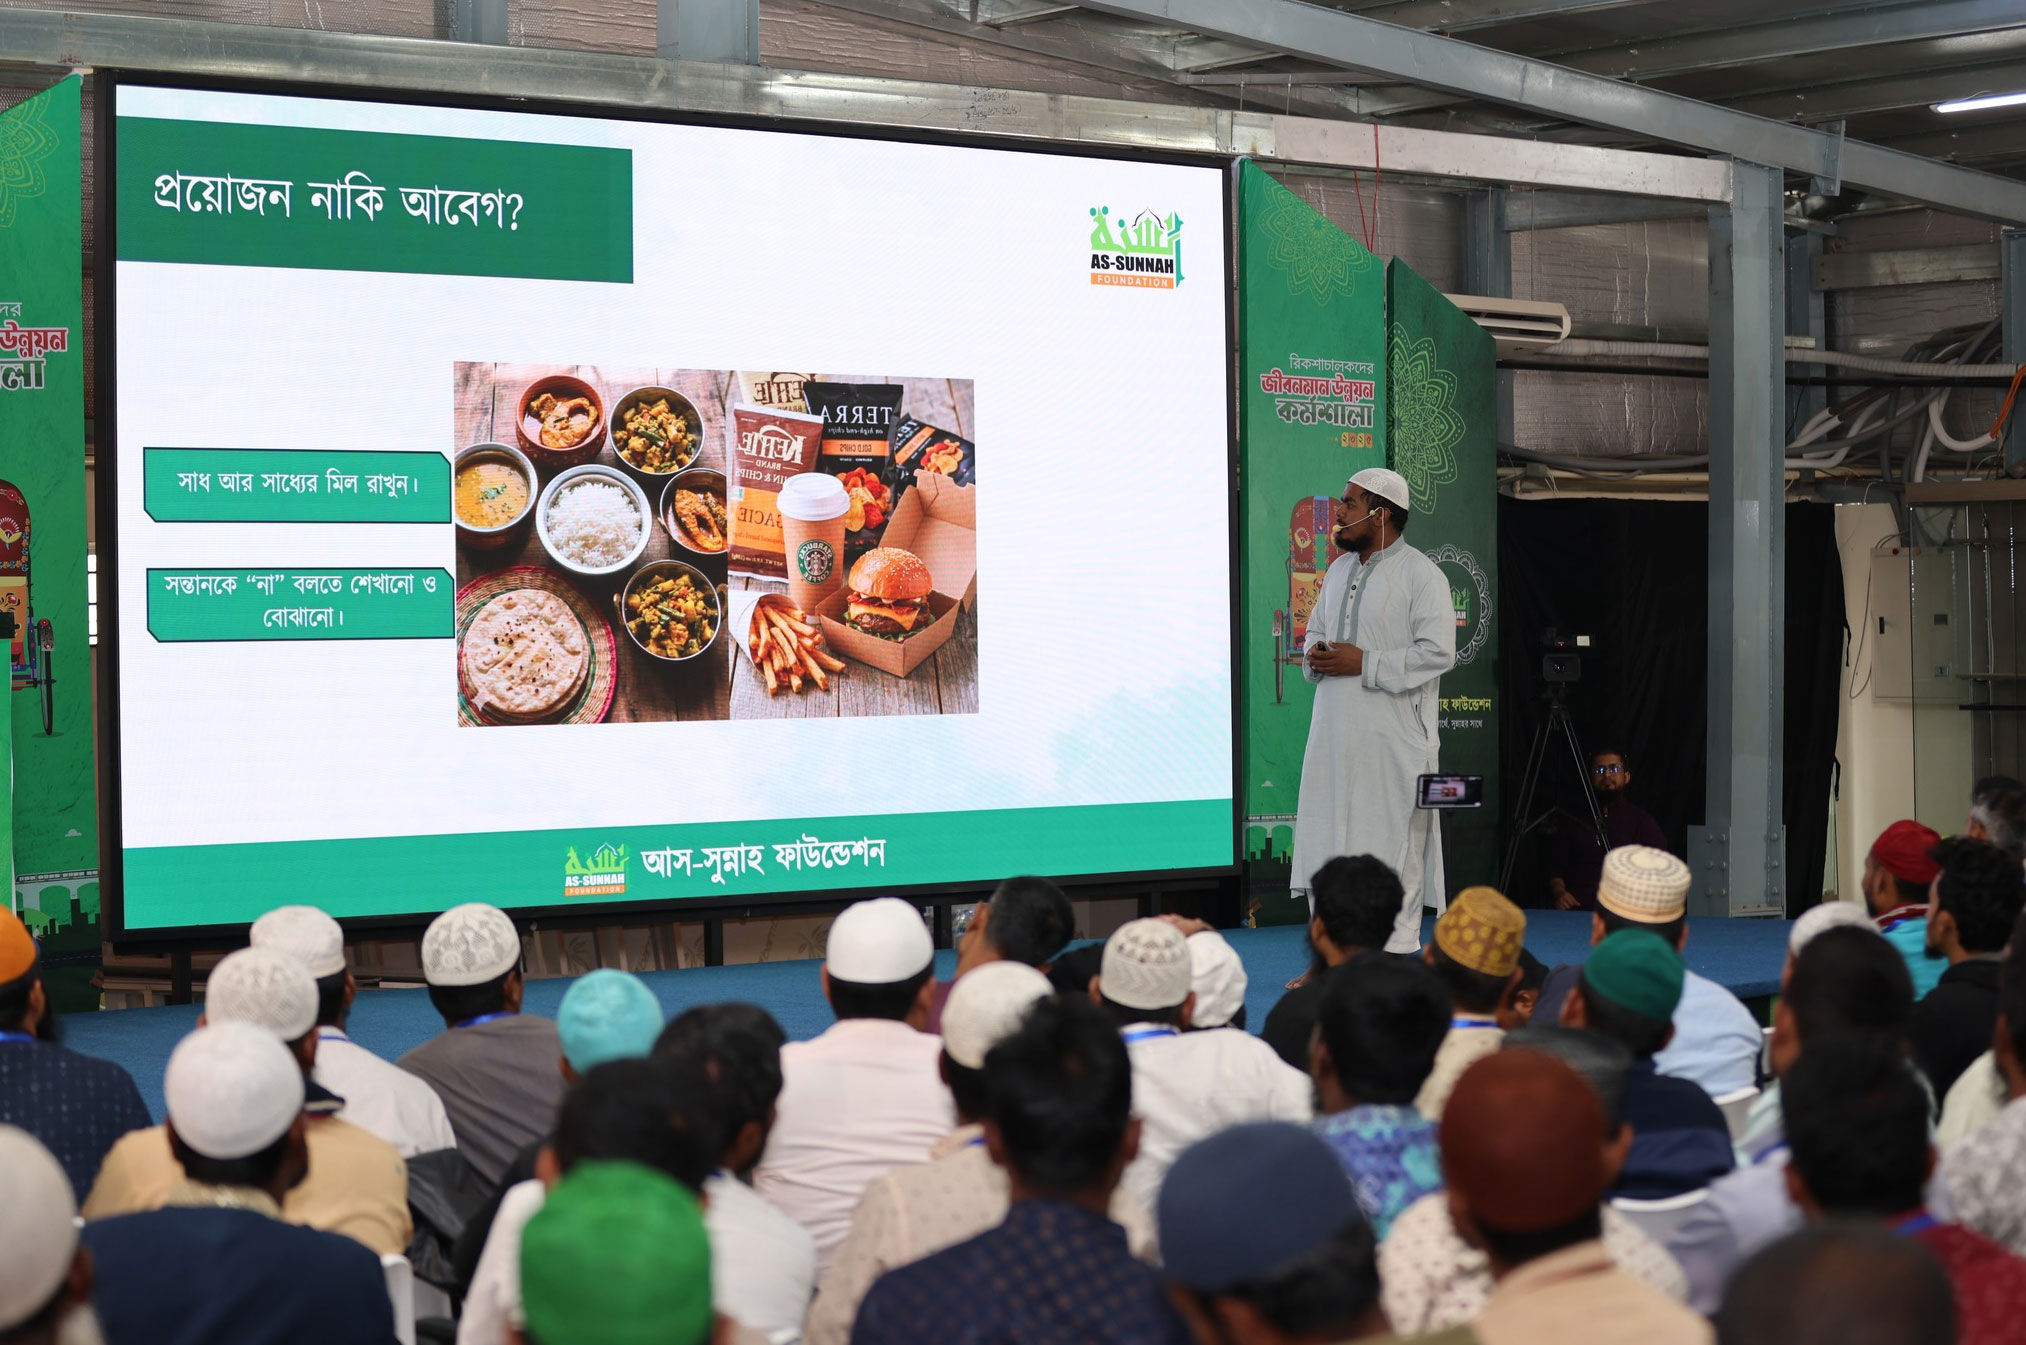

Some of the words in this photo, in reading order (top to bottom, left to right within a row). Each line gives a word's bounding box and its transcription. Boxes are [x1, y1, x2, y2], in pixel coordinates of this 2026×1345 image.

[154, 169, 293, 218] প্রয়োজন
[307, 170, 386, 221] নাকি
[399, 185, 524, 231] আবেগ?
[1091, 254, 1174, 274] AS-SUNNAH
[1097, 275, 1168, 287] FOUNDATION
[1289, 353, 1375, 374] রিকশাচালকদের
[1260, 368, 1330, 397] জীবনমান
[1331, 373, 1375, 403] উন্নয়ন
[1275, 395, 1375, 428] কর্মশালা
[178, 471, 210, 493] সাধ
[218, 472, 253, 493] আর
[262, 472, 318, 494] সাধ্যের
[325, 468, 358, 494] মিল
[164, 574, 237, 596] সন্তানকে
[292, 575, 343, 595] বলতে
[350, 574, 415, 595] শেখানো
[423, 577, 437, 593] ও
[1451, 694, 1491, 712] ফাউন্ডেশন
[641, 842, 765, 885] আস-সুন্নাহ
[773, 833, 886, 871] ফাউন্ডেশন
[565, 873, 625, 887] AS-SUNNAH
